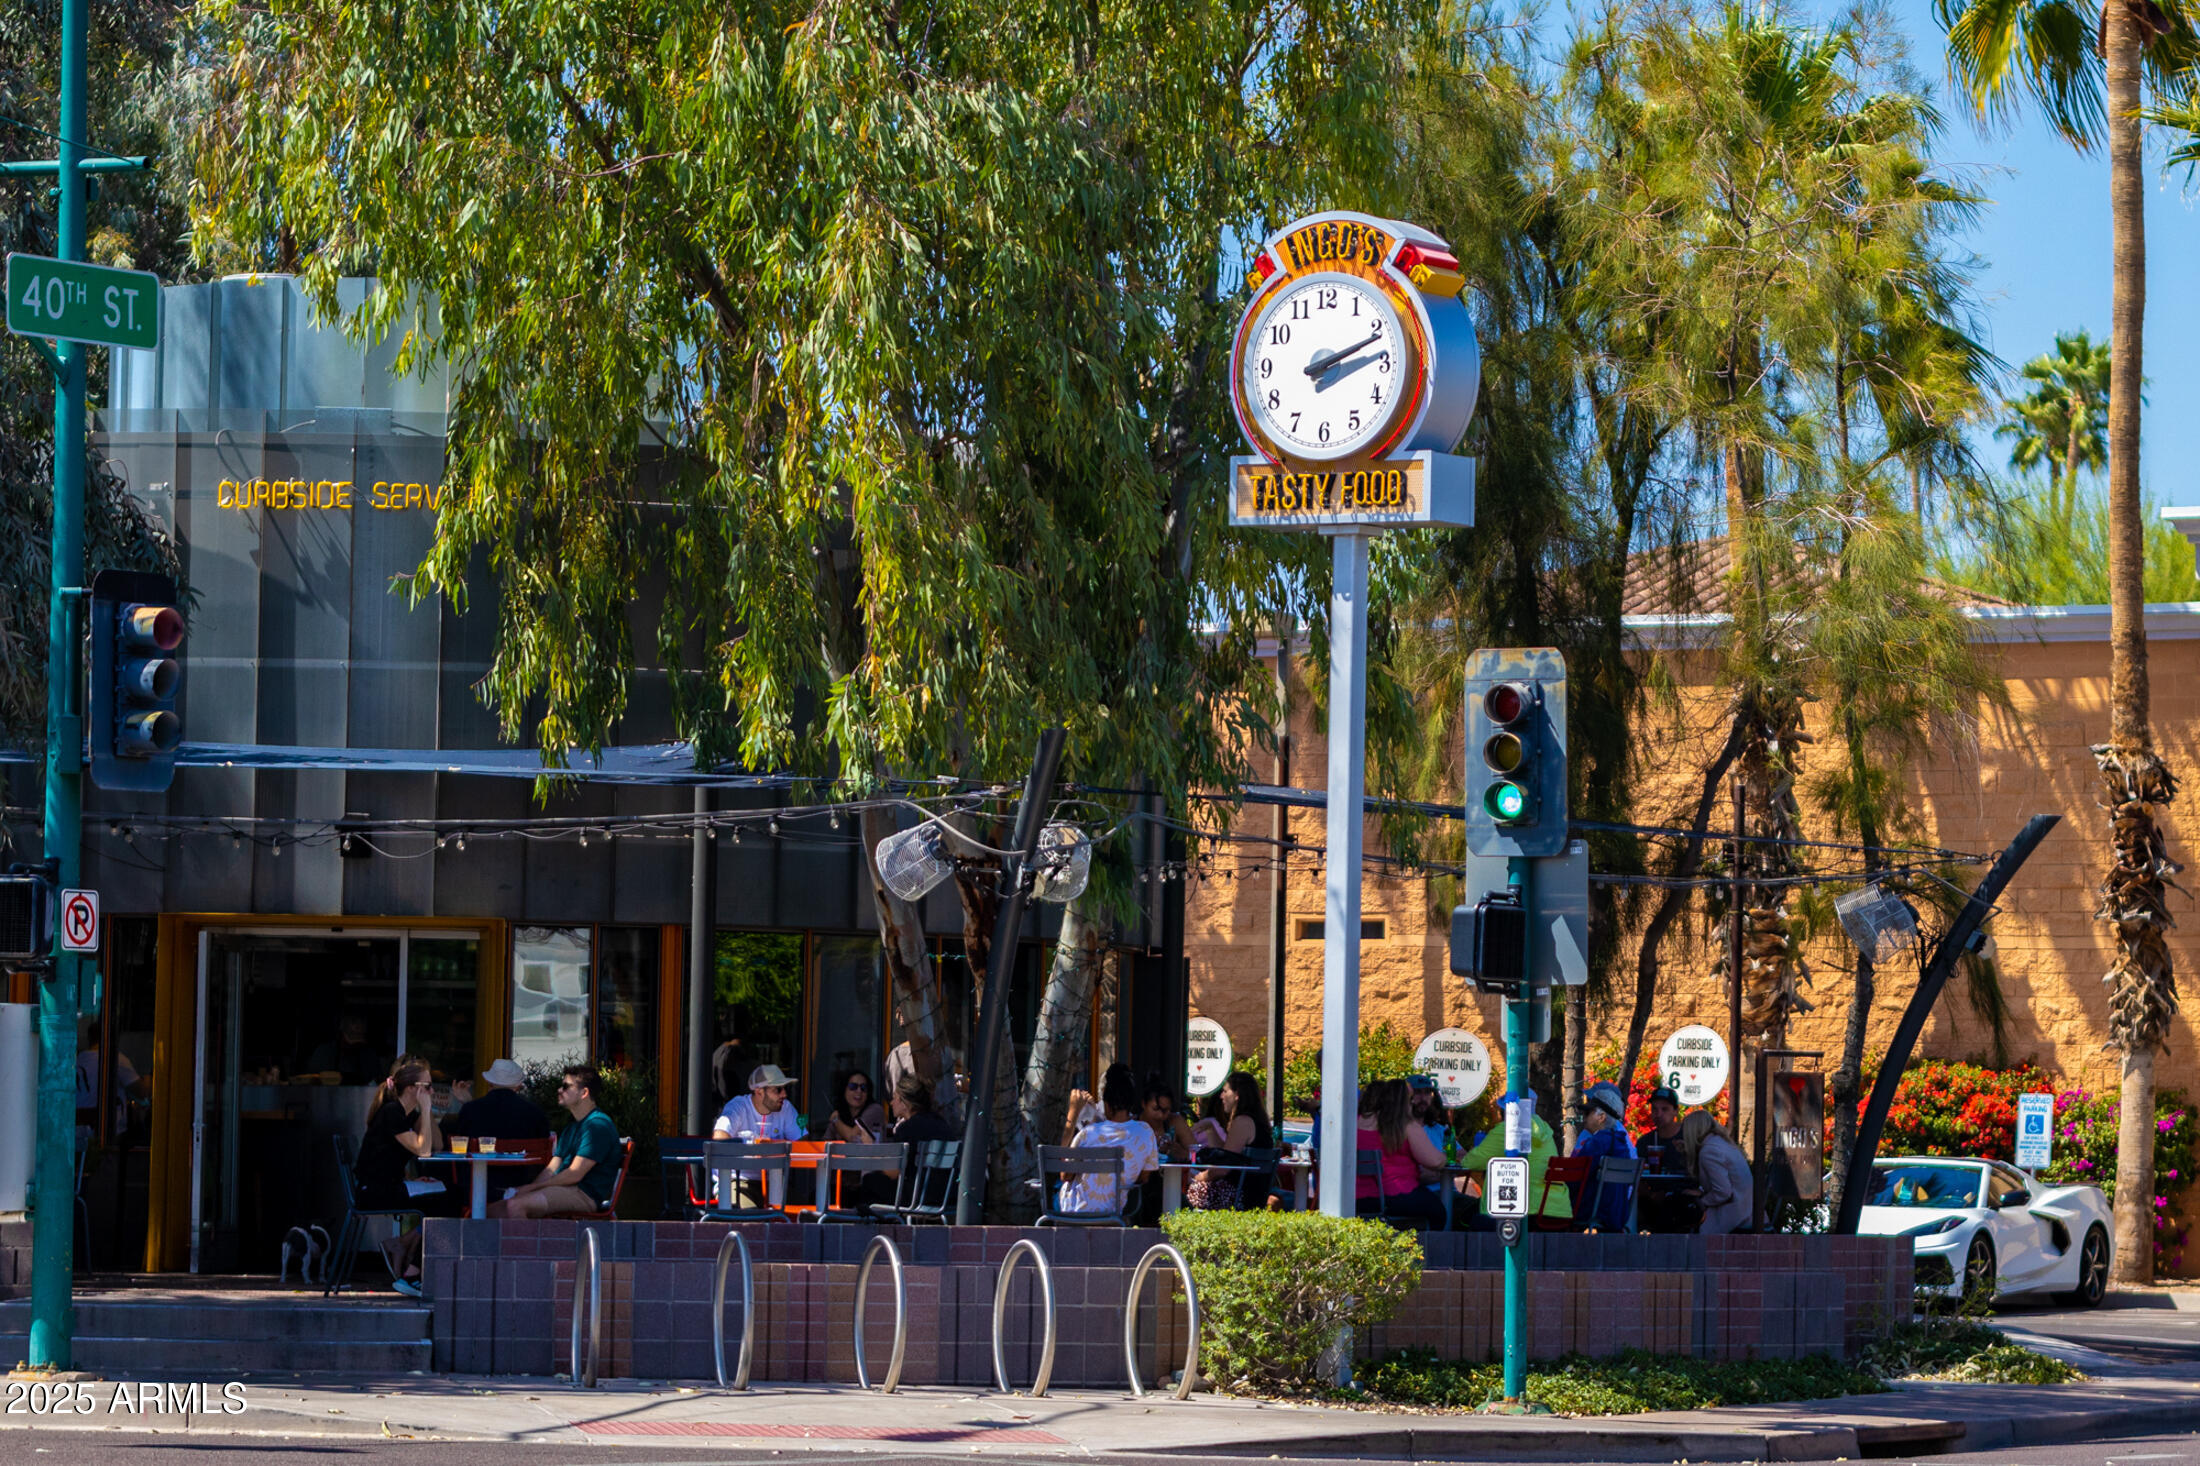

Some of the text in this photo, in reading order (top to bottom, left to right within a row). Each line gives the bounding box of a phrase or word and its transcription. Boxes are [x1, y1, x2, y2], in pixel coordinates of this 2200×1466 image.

[1284, 222, 1385, 269] INGO'S
[22, 275, 142, 331] 40TH ST.
[1291, 299, 1310, 320] 11
[1316, 288, 1338, 310] 12
[1351, 296, 1361, 317] 1
[1269, 323, 1291, 346] 10
[1370, 318, 1384, 337] 2
[1260, 357, 1273, 379] 9
[1379, 352, 1391, 374] 3
[1268, 388, 1281, 410] 8
[1370, 383, 1382, 405] 4
[1290, 411, 1302, 433] 7
[1348, 409, 1361, 431] 5
[1318, 421, 1331, 443] 6
[218, 480, 479, 511] CURBSIDE SERV
[1250, 470, 1407, 511] TASTY FOOD
[1189, 1030, 1216, 1041] URBSIDE
[1677, 1038, 1713, 1051] CURBSIDE
[1188, 1047, 1223, 1059] KING ONLY
[1434, 1040, 1473, 1054] CURBSIDE
[1424, 1057, 1482, 1072] PARKING ONLY
[1667, 1055, 1721, 1069] PARKING ONLY
[1668, 1071, 1681, 1089] 6
[1496, 1170, 1520, 1178] BUTTON
